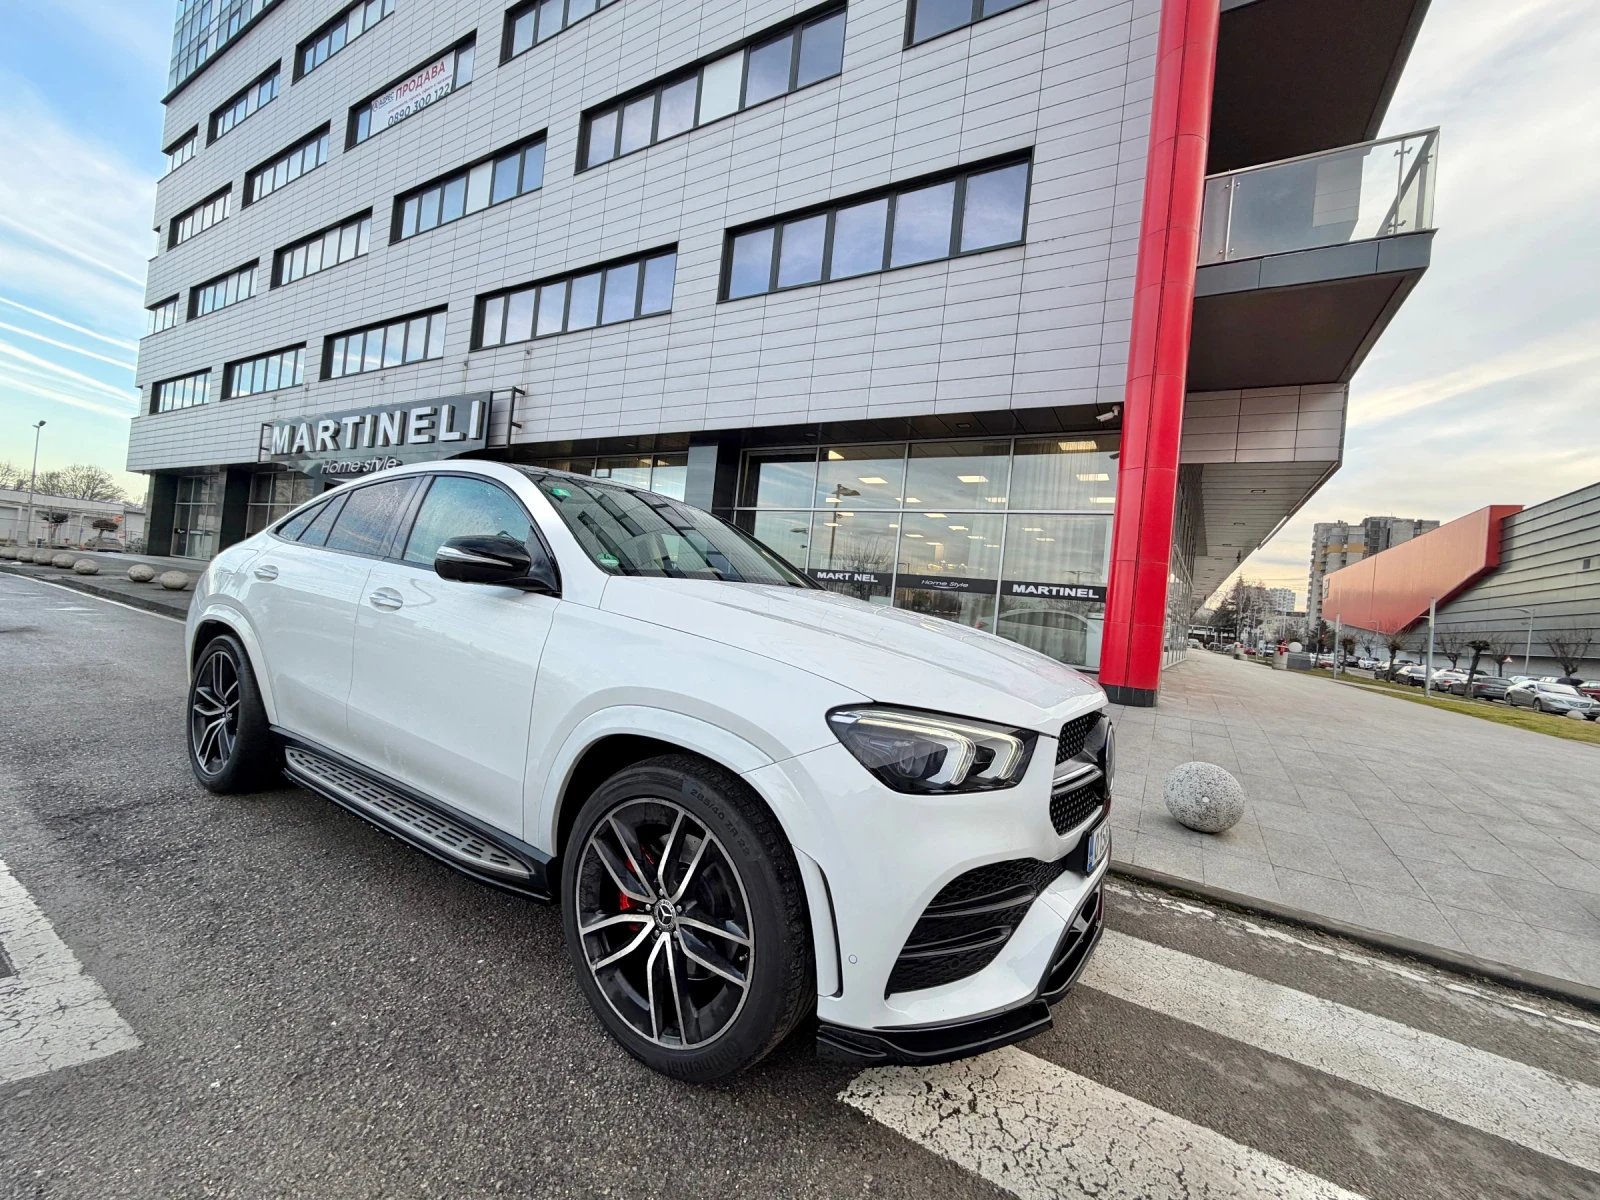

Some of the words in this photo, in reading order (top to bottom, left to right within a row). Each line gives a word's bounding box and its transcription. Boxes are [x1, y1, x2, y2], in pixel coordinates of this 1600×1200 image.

[396, 61, 445, 100] ПРОДАВА
[388, 105, 411, 127] 0890
[413, 93, 432, 113] 300
[434, 82, 450, 101] 122
[271, 400, 486, 455] MARTINELI
[320, 459, 361, 475] Home
[362, 455, 397, 473] style
[921, 579, 948, 587] Home
[949, 581, 969, 589] Style
[1012, 583, 1099, 599] MARTINEL
[690, 788, 725, 820] 285/40
[724, 820, 739, 837] ZR
[737, 838, 751, 857] 22
